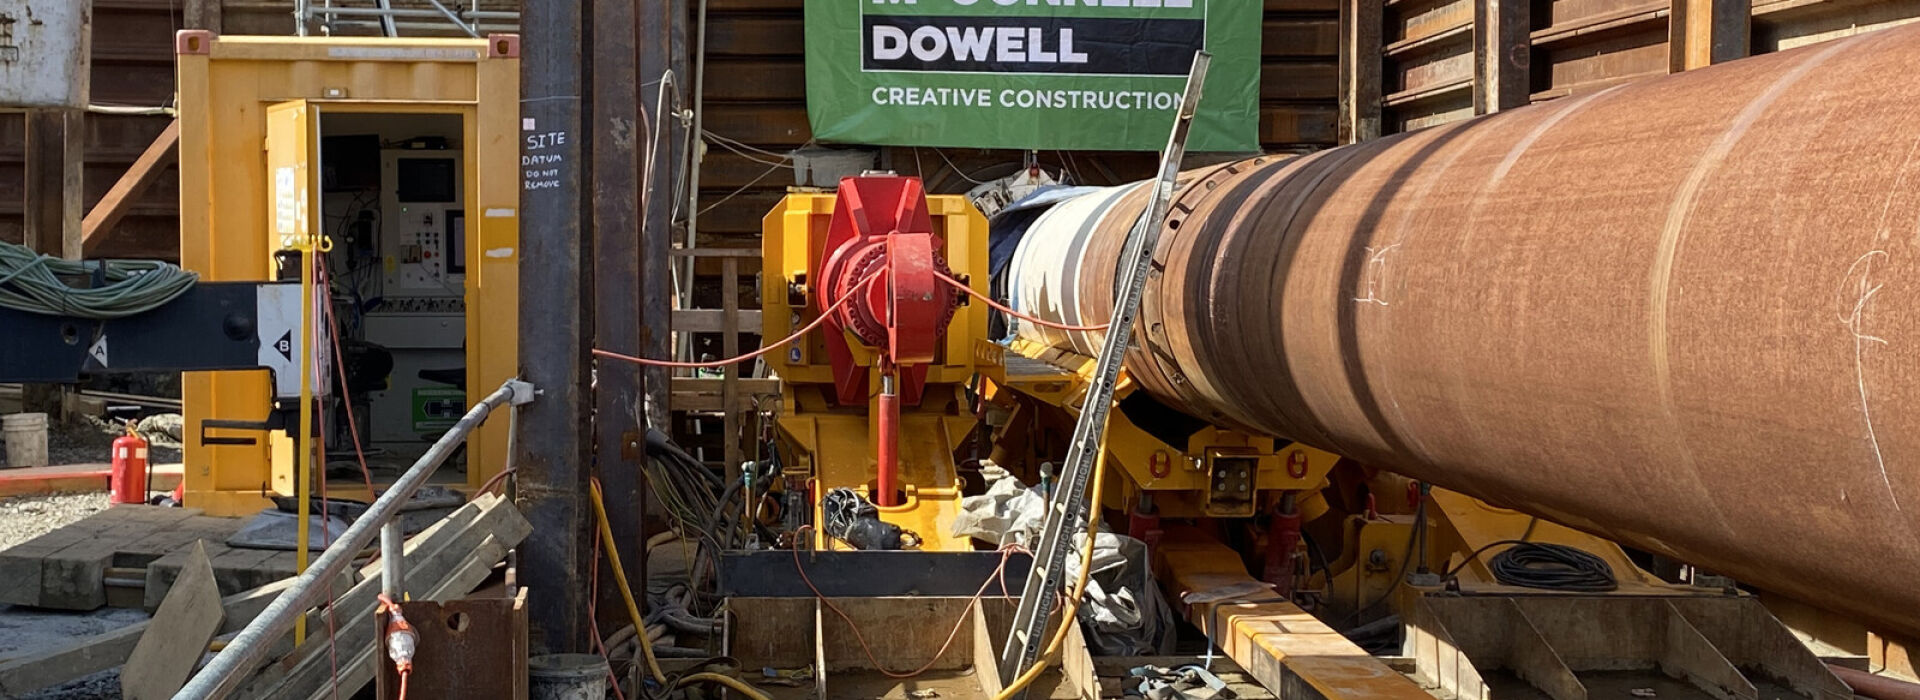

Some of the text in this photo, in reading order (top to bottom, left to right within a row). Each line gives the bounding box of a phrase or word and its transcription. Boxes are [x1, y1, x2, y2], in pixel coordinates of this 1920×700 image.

[872, 25, 1088, 63] DOWELL
[872, 86, 992, 107] CREATIVE
[527, 132, 565, 149] SITE
[522, 154, 562, 166] DATUM
[526, 169, 558, 178] DO NOT
[525, 180, 560, 190] REMOVE
[1127, 261, 1146, 309] ULLRICH
[95, 344, 105, 356] A
[279, 341, 289, 352] B
[1108, 327, 1128, 374] ULLRICH
[1070, 458, 1089, 505] ULLRICH
[1052, 525, 1070, 571] ULLRICH
[1033, 591, 1051, 637] ULLRICH
